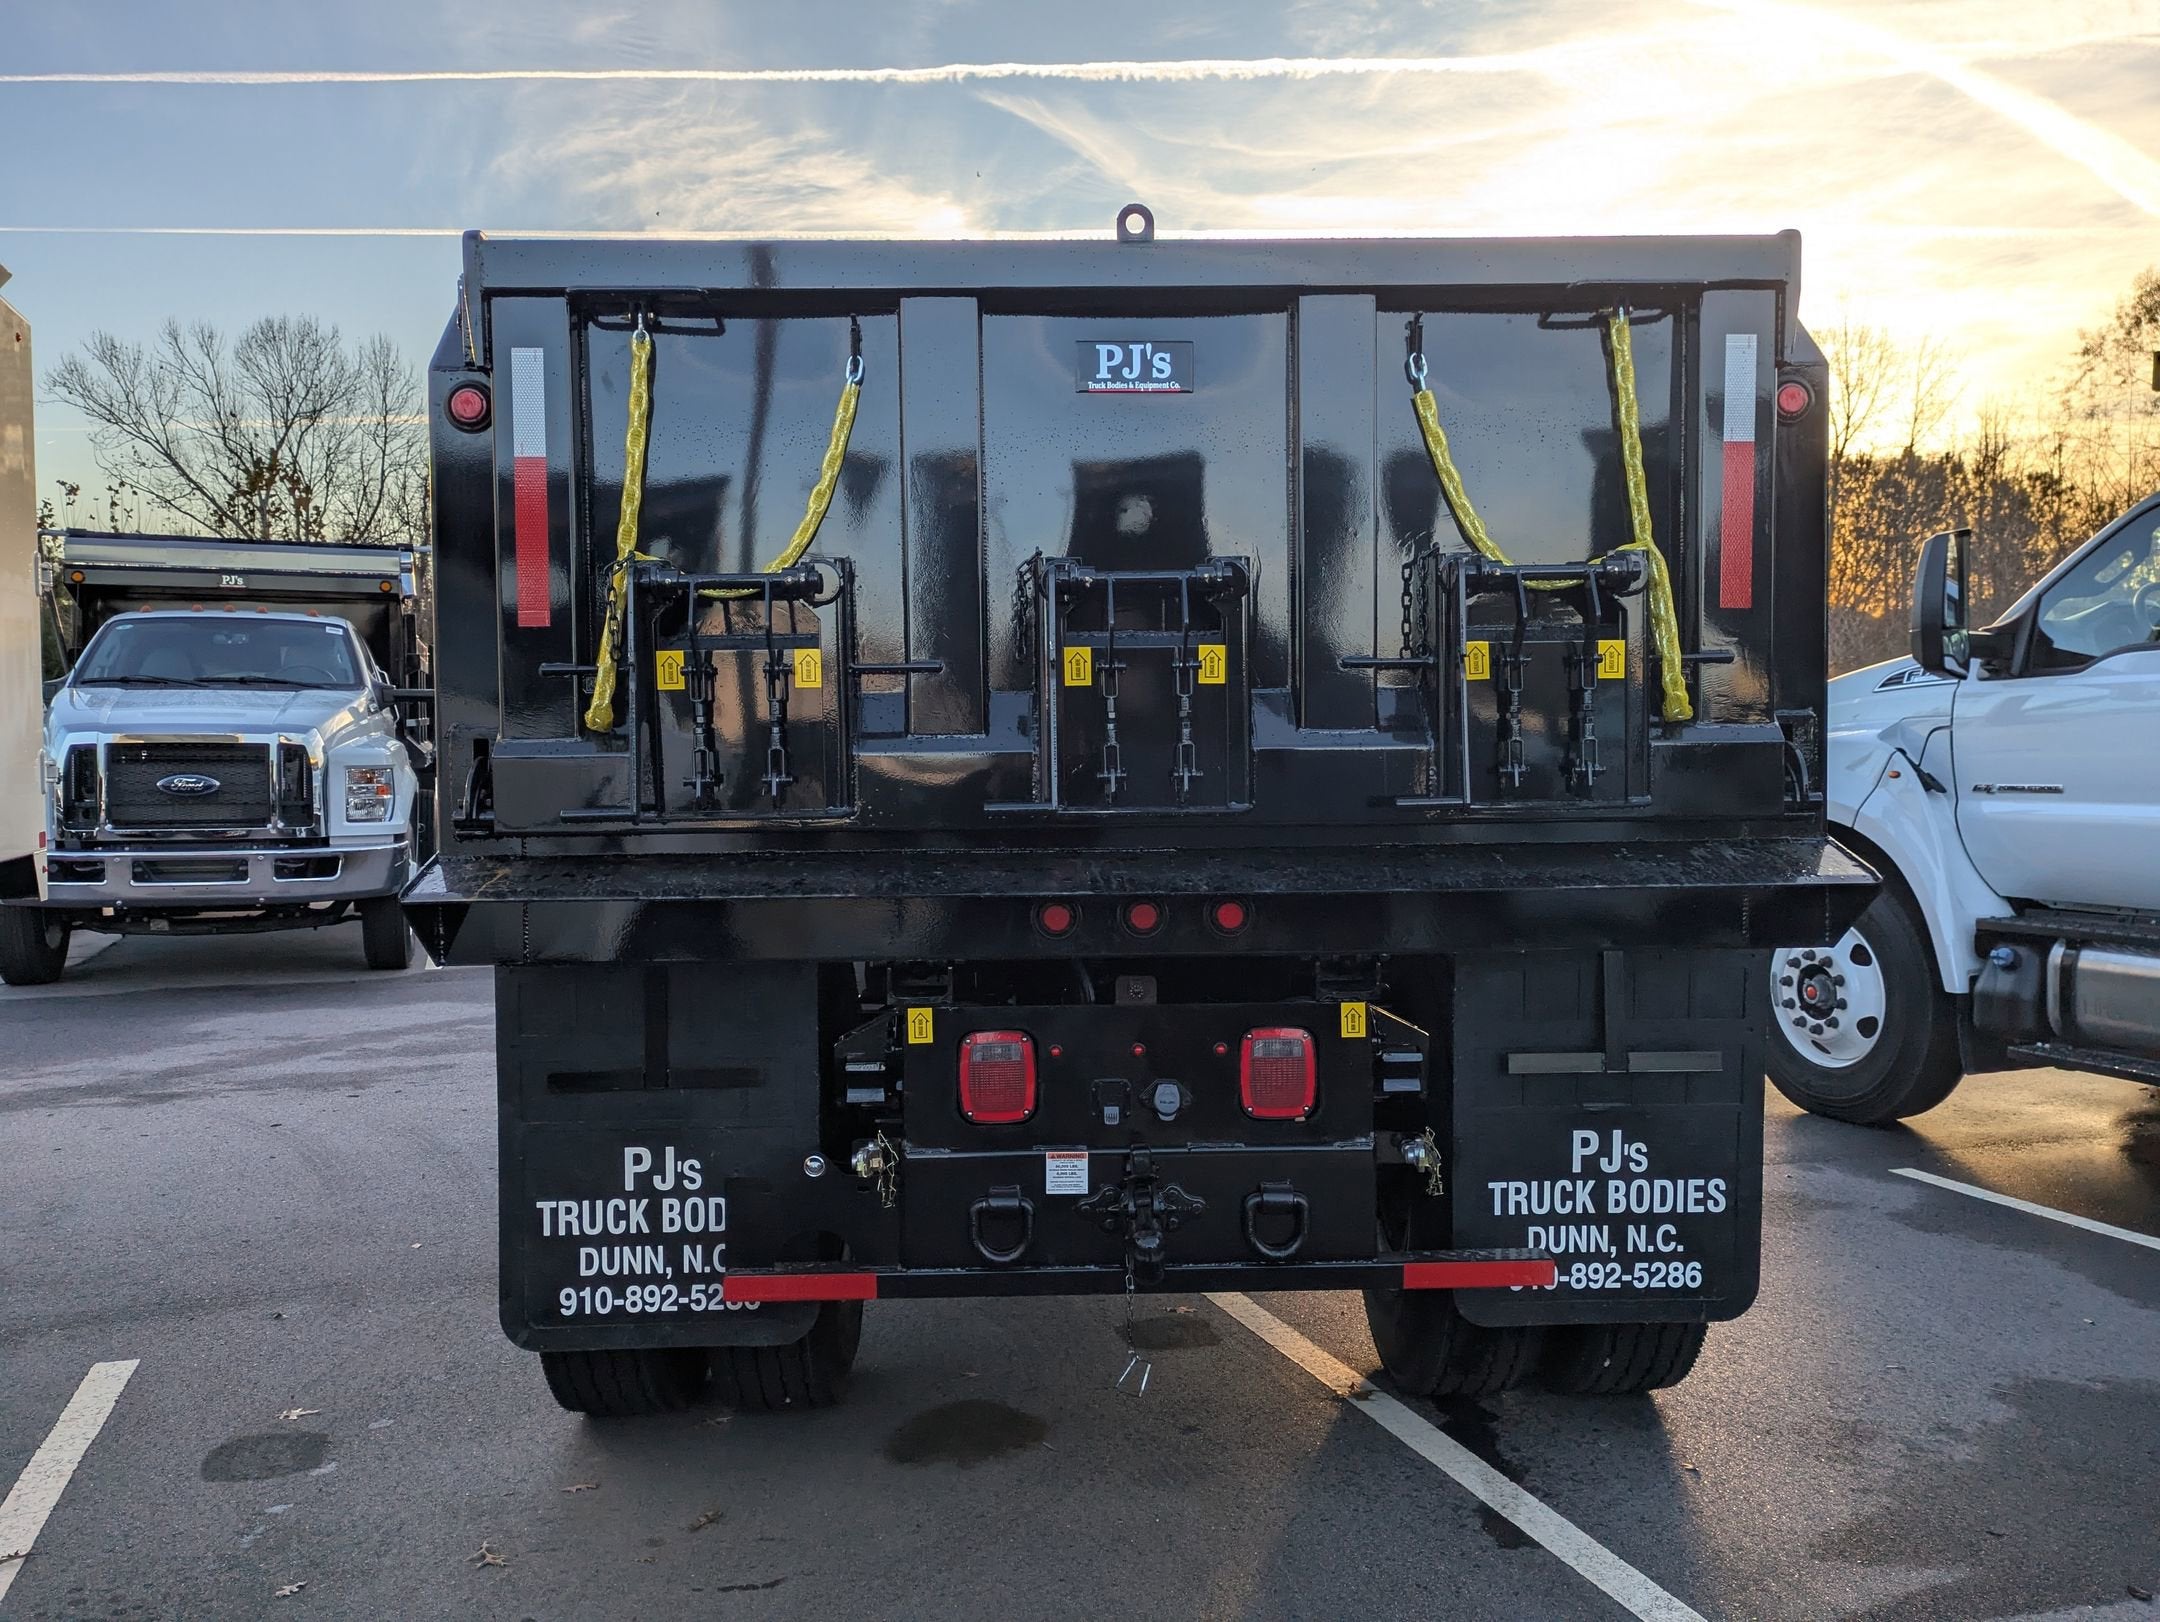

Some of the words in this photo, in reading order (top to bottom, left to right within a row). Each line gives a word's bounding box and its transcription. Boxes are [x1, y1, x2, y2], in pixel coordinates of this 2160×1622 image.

[1095, 343, 1172, 379] PJ's
[1135, 382, 1169, 391] Equipment
[1170, 381, 1181, 389] Co.
[221, 575, 244, 585] PJ's
[171, 778, 205, 790] Ford
[623, 1146, 702, 1191] PJ's
[1571, 1129, 1649, 1174] PJ's
[1488, 1180, 1597, 1216] TRUCK
[1608, 1178, 1727, 1214] BODIES
[536, 1198, 650, 1237] TRUCK
[662, 1197, 726, 1233] BOD
[1527, 1225, 1617, 1258] DUNN,
[1627, 1223, 1685, 1253] N.C.
[579, 1245, 673, 1280] DUNN,
[683, 1243, 726, 1273] N.C
[1510, 1261, 1703, 1291] -892-5286
